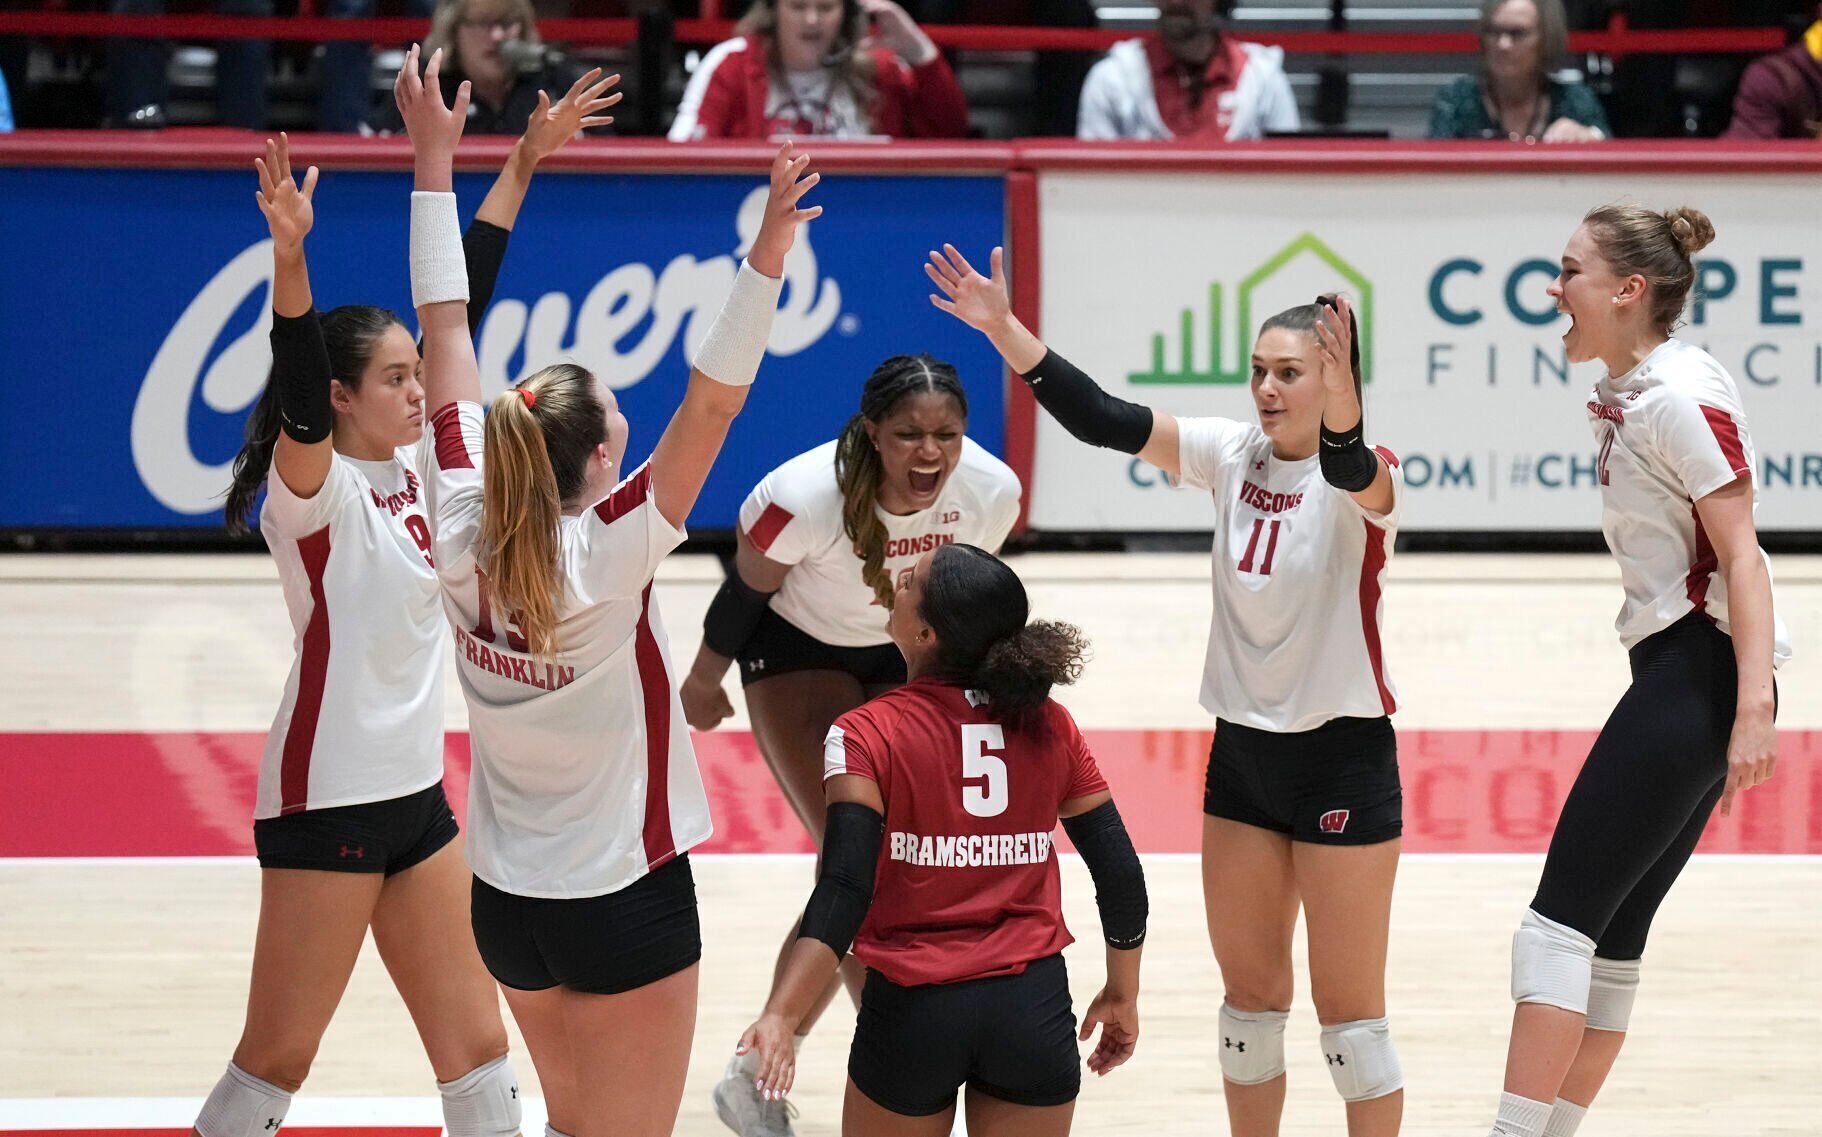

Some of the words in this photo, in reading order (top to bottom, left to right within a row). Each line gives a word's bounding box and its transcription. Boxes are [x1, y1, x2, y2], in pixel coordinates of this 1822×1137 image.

[1427, 258, 1804, 326] COPE
[1427, 342, 1822, 386] FINCI
[1237, 518, 1281, 576] 11
[456, 624, 575, 691] FRANKLIN
[960, 723, 1009, 818] 5
